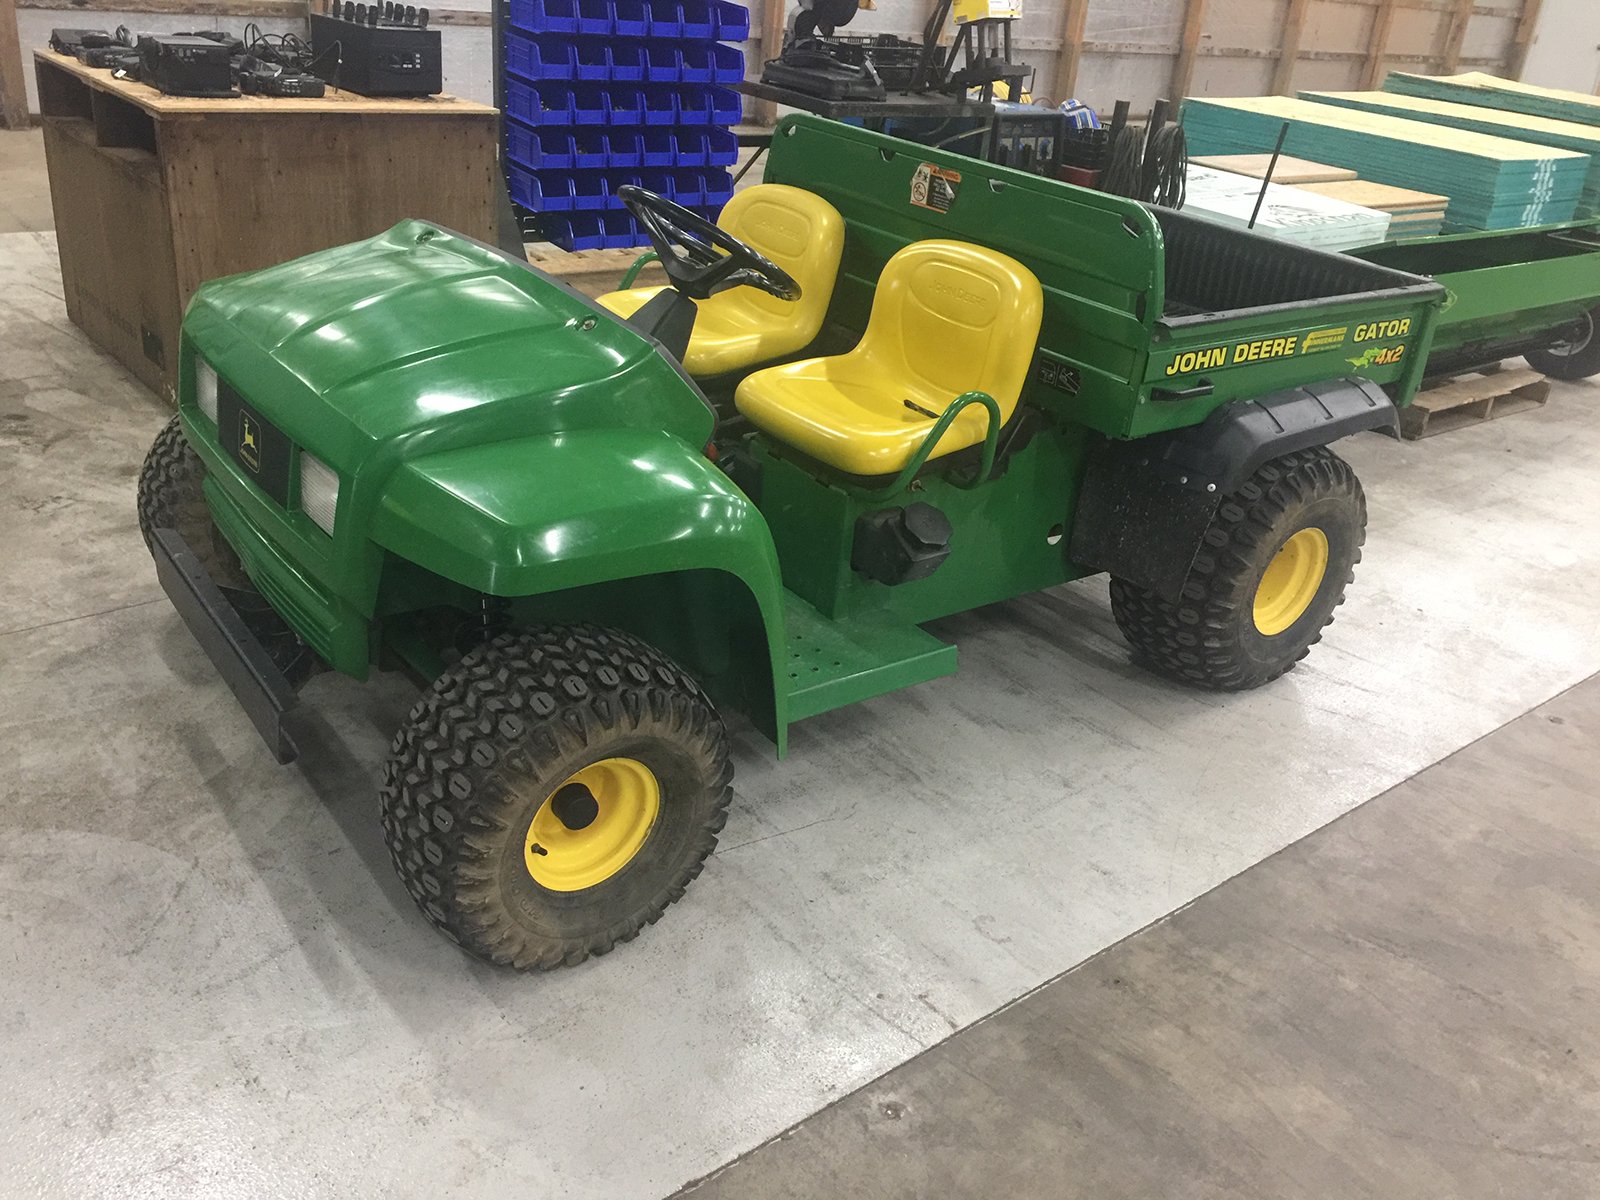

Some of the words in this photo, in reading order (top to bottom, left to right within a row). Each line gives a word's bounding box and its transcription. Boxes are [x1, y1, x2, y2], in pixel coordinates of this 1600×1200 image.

[1353, 318, 1410, 342] GATOR
[1165, 346, 1227, 376] JOHN
[1232, 336, 1297, 364] DEERE
[1374, 345, 1404, 365] 4x2
